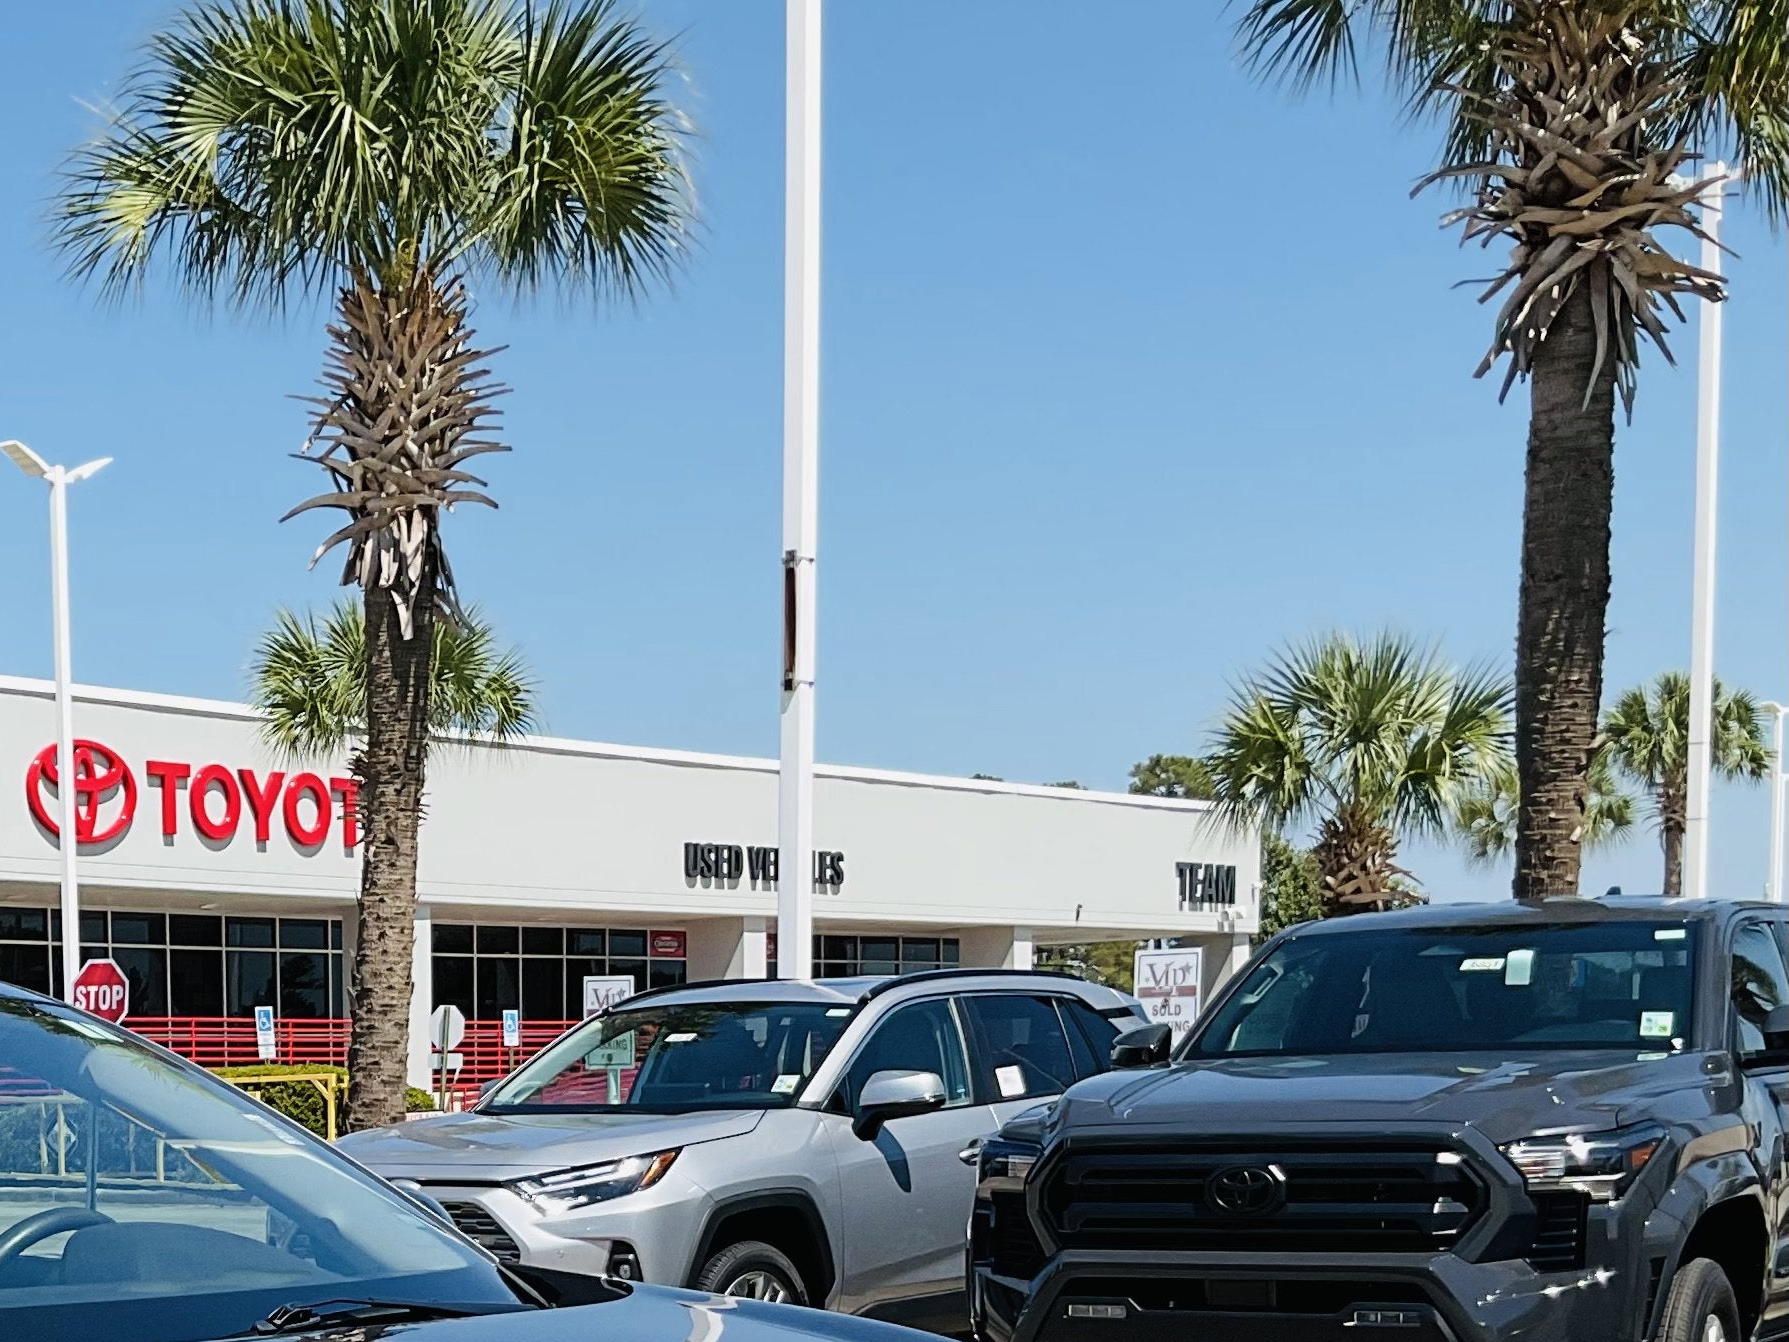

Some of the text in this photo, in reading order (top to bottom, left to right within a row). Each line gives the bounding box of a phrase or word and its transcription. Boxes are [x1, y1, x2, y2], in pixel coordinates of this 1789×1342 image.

[146, 760, 362, 848] TOYOT
[684, 842, 844, 885] USED VELES
[1175, 861, 1236, 905] TEAM
[75, 985, 123, 1010] STOP
[1152, 1004, 1181, 1016] SOLD
